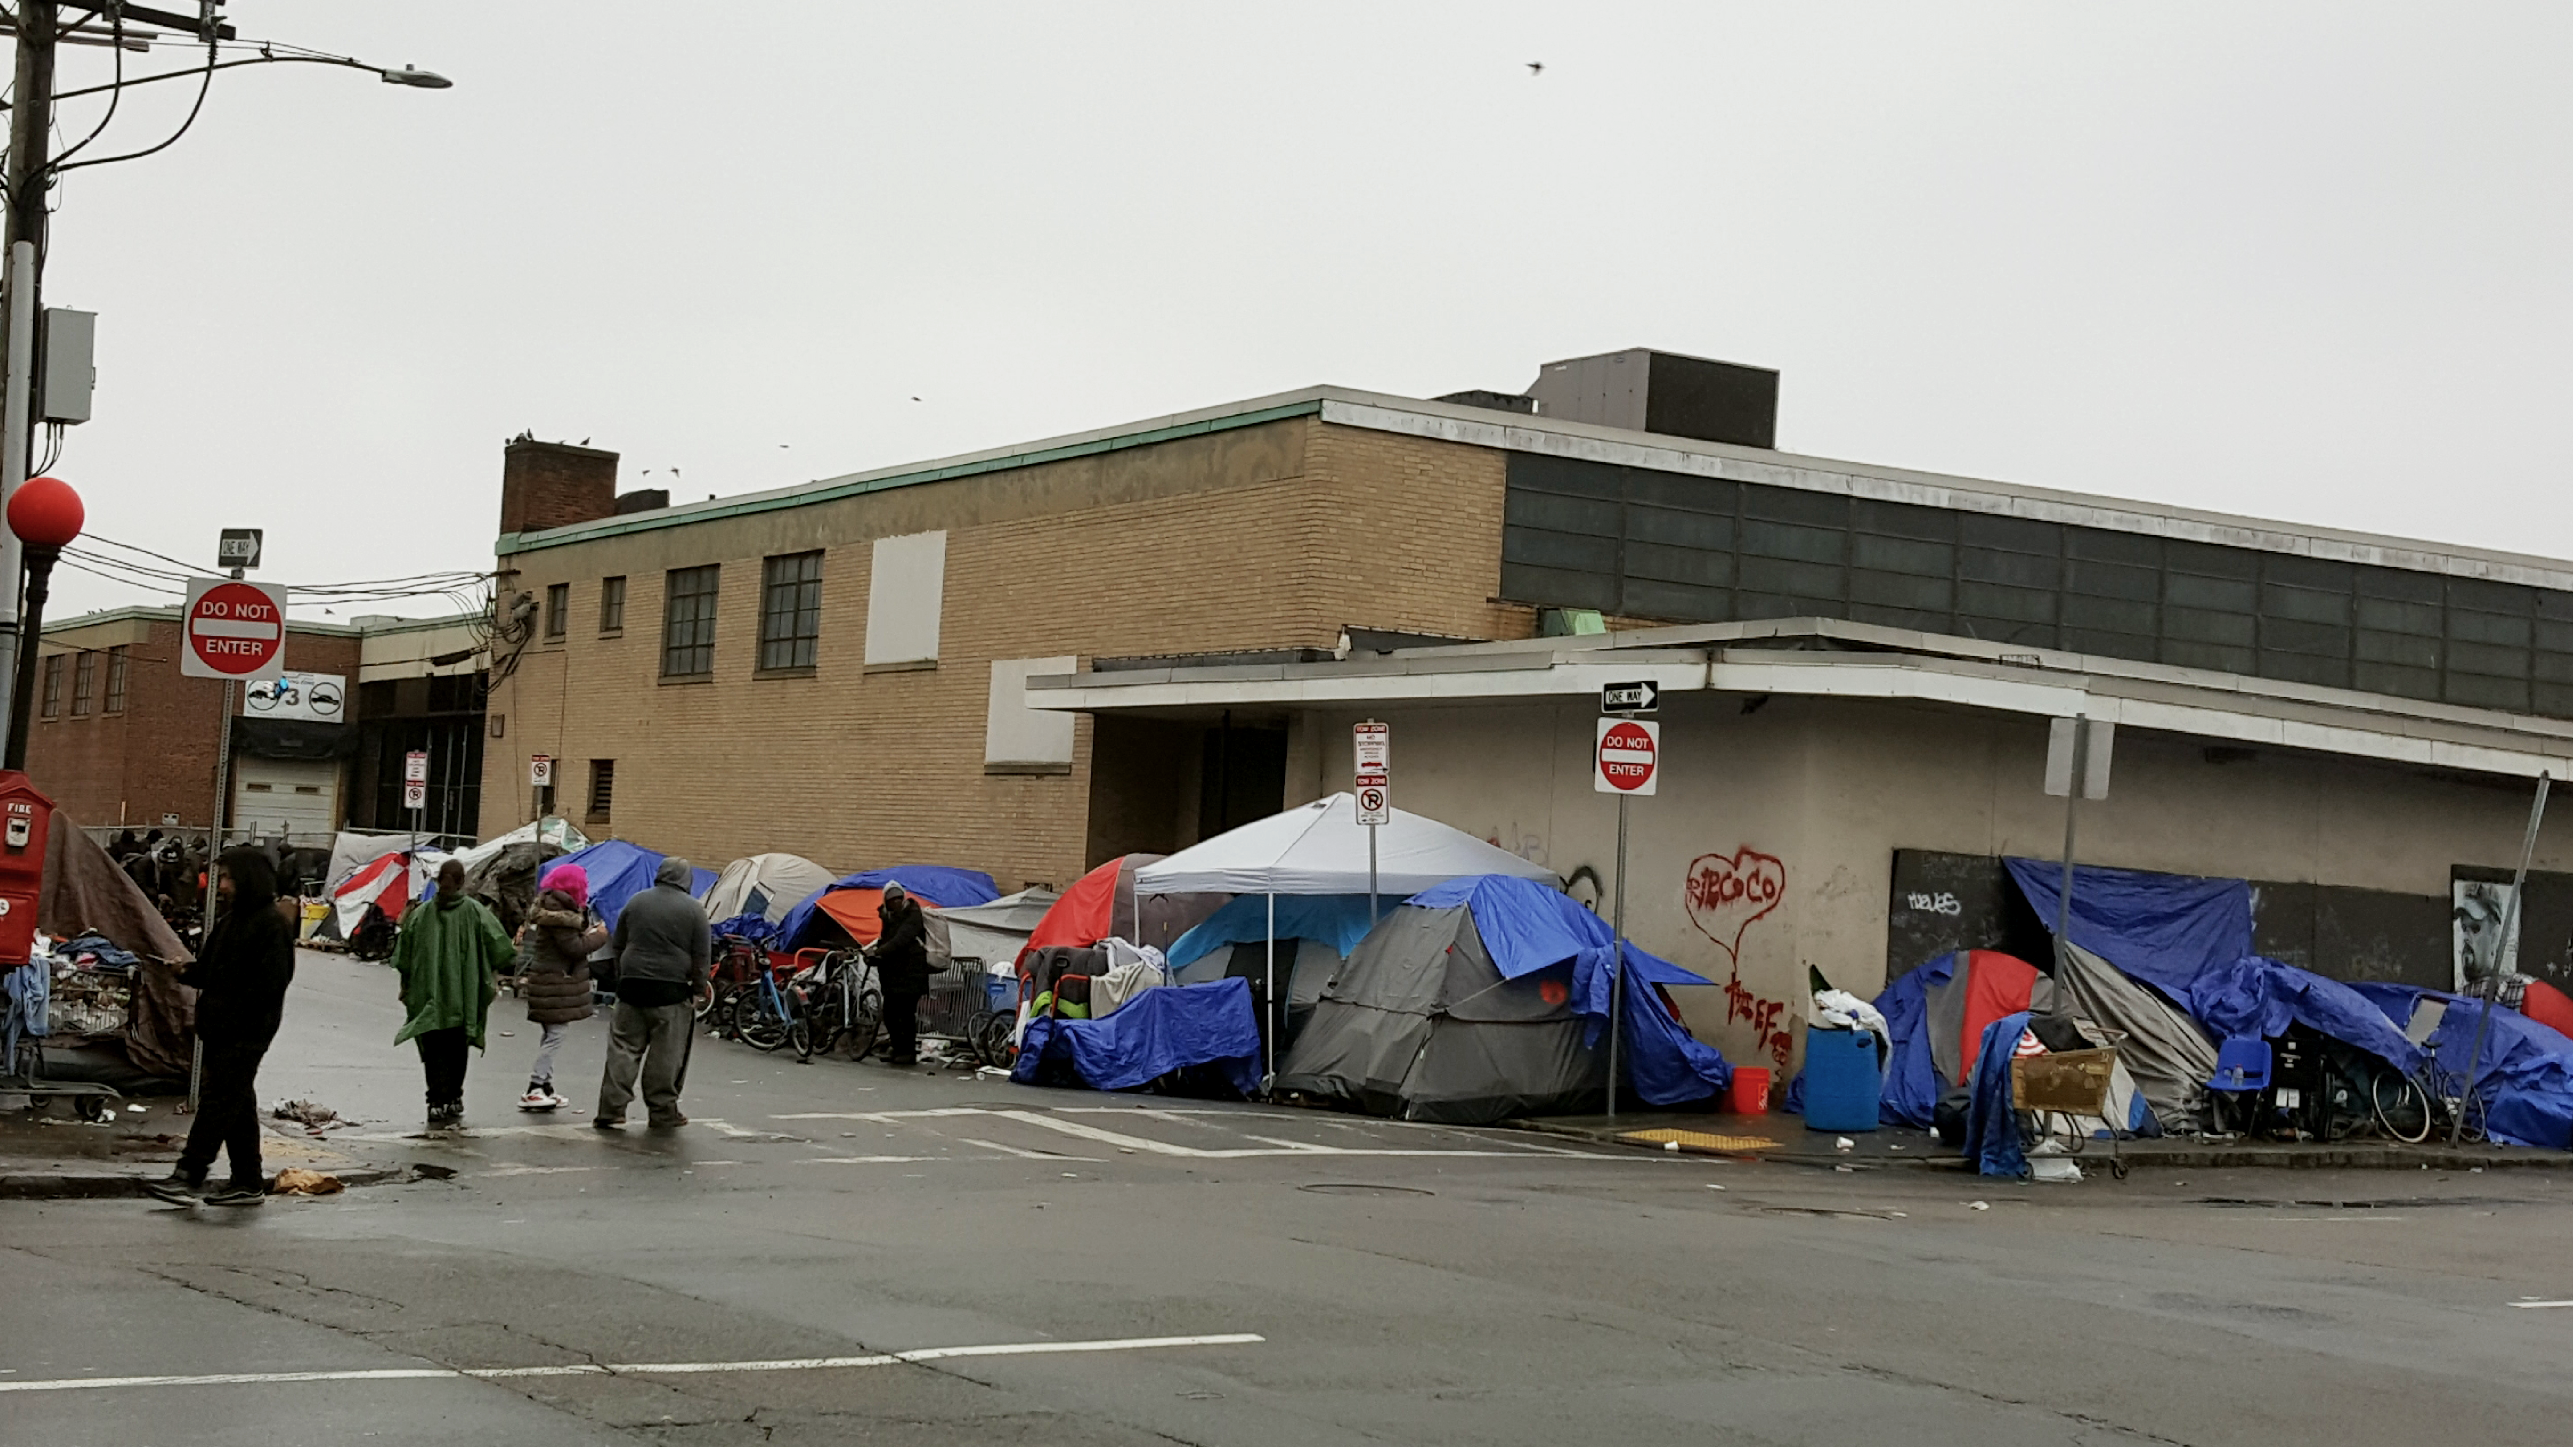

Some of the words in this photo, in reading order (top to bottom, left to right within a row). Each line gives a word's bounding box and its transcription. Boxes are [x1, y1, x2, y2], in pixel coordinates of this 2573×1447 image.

[222, 540, 236, 555] ONE
[202, 601, 228, 617] DO
[235, 603, 272, 619] NOT
[205, 639, 263, 656] ENTER
[1608, 690, 1623, 703] ONE
[1626, 689, 1642, 702] WAY
[1606, 736, 1623, 748] DO
[1626, 737, 1650, 750] NOT
[1608, 763, 1645, 777] ENTER
[8, 803, 32, 814] FIRE
